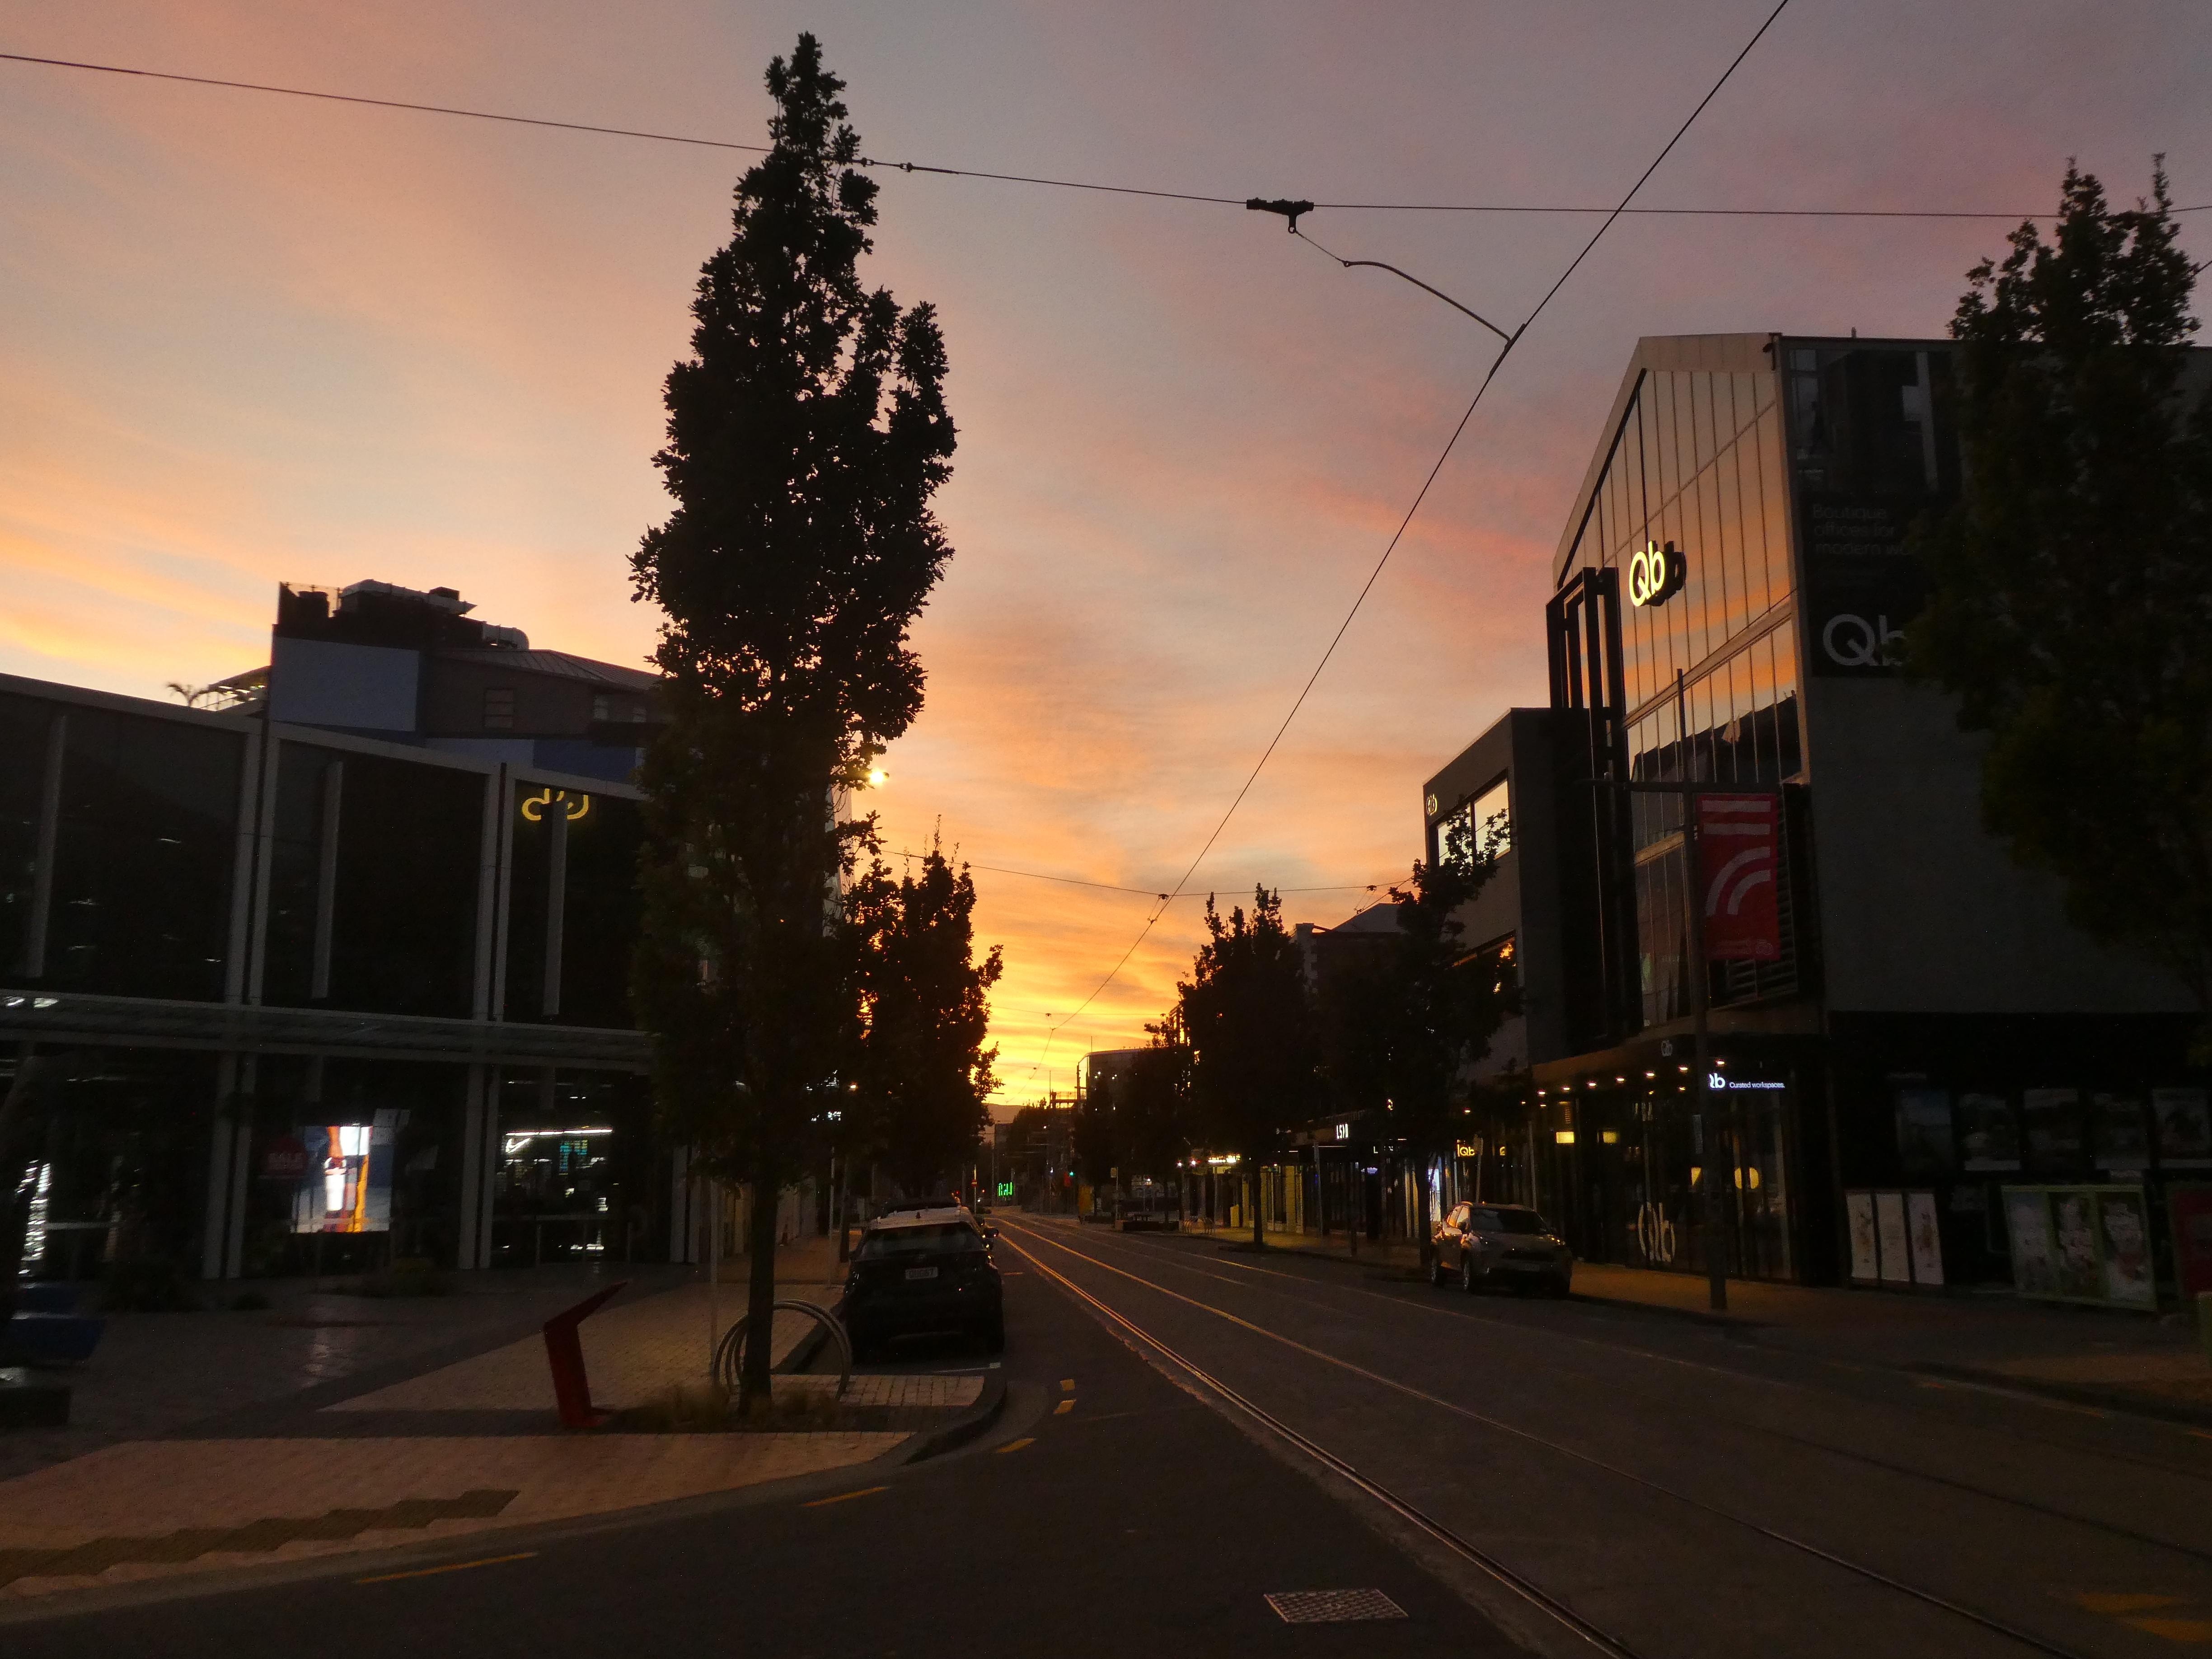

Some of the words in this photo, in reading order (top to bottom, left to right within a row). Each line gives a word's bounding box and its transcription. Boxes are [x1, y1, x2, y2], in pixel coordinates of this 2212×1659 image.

[1812, 504, 1887, 521] Boutique
[1814, 521, 1868, 537] offices
[1873, 522, 1896, 538] for
[1815, 543, 1881, 555] modern
[1629, 541, 1667, 607] Qb
